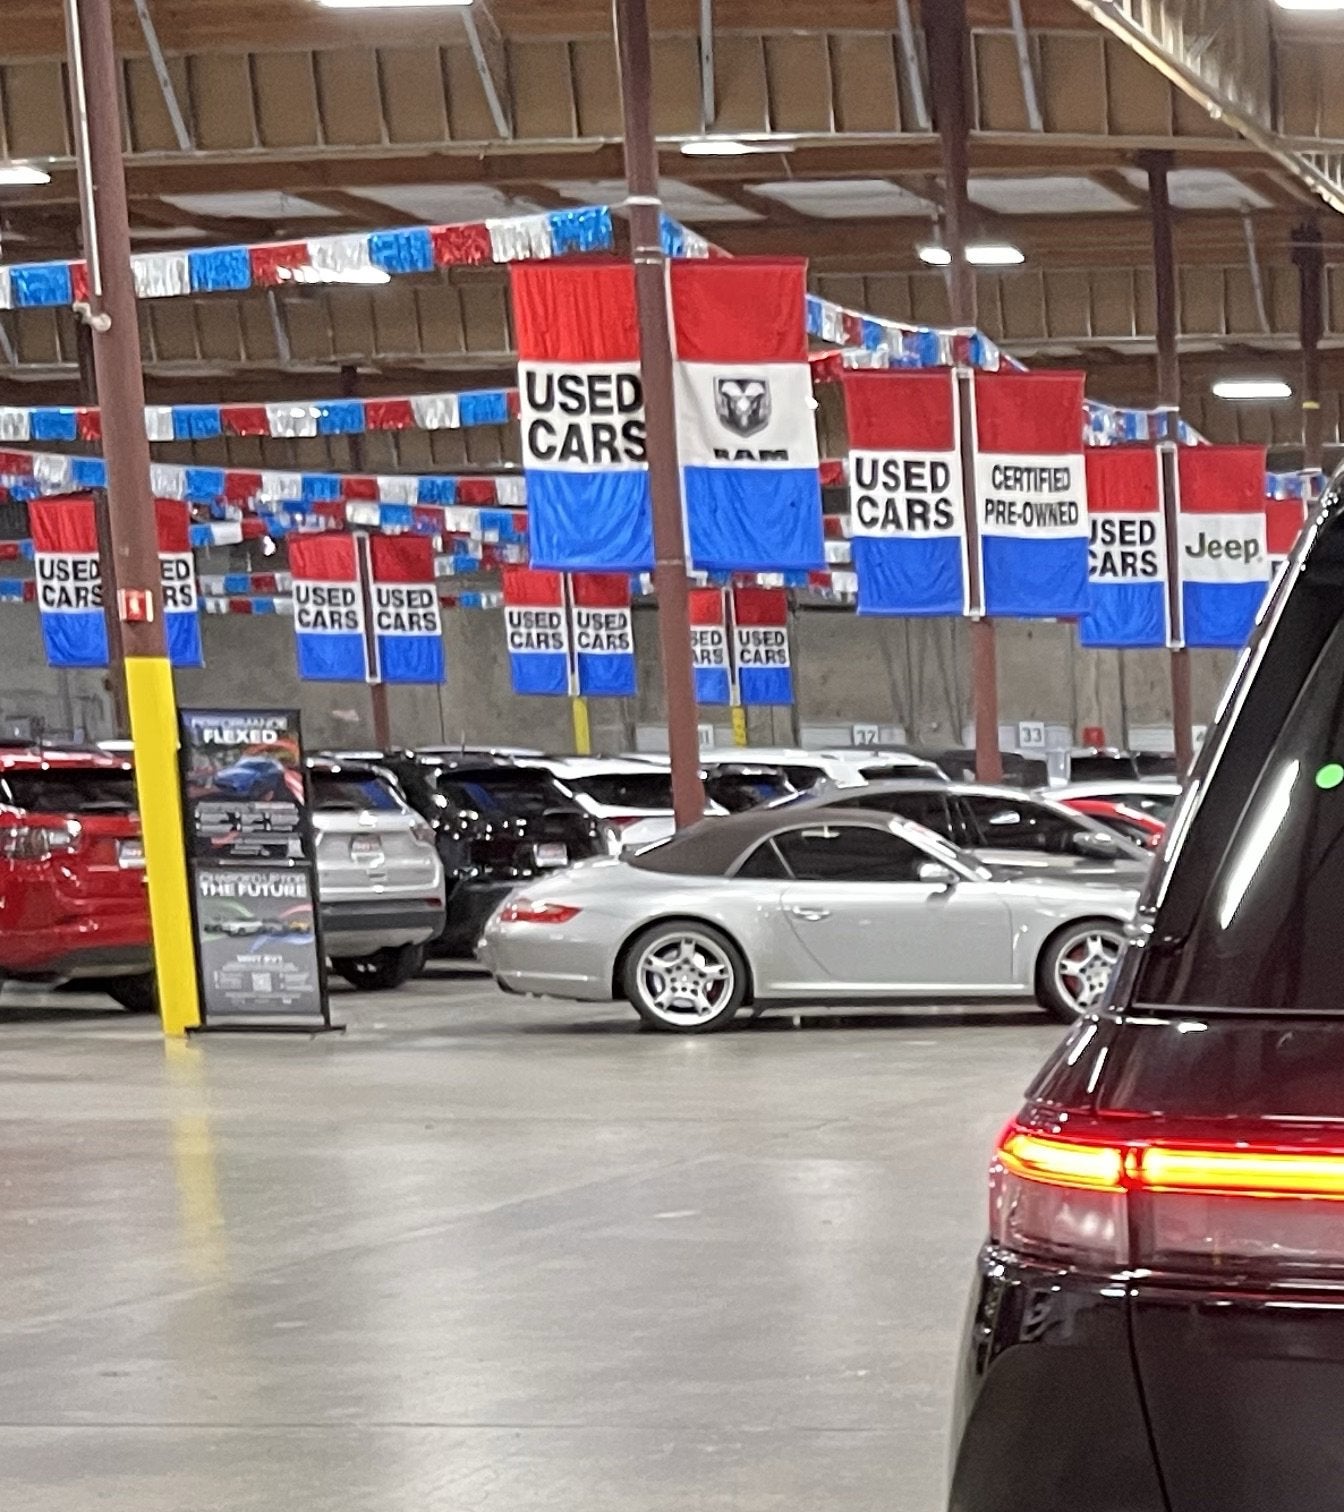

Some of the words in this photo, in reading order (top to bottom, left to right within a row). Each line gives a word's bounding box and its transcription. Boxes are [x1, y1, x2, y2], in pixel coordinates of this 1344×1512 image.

[526, 371, 644, 415] USED
[527, 418, 646, 464] CARS
[855, 457, 950, 494] USED
[992, 465, 1071, 492] CERTIFIED
[857, 495, 955, 530] CARS
[985, 498, 1079, 527] PRE-OWNED
[1185, 532, 1260, 564] Jeep
[160, 559, 190, 581] ED
[296, 586, 356, 606] USED
[377, 588, 434, 608] USED
[298, 609, 359, 630] CARS
[377, 611, 437, 631] CARS
[508, 611, 561, 629] USED
[577, 612, 629, 629] USED
[510, 632, 564, 649] CARS
[577, 632, 630, 650] CARS
[691, 630, 723, 646] SED
[739, 631, 786, 646] USED
[692, 649, 724, 664] ARS
[739, 649, 787, 664] CARS
[203, 729, 278, 744] FLEXED
[1022, 727, 1042, 742] 33
[200, 882, 235, 896] THE
[238, 883, 308, 898] FUTURE
